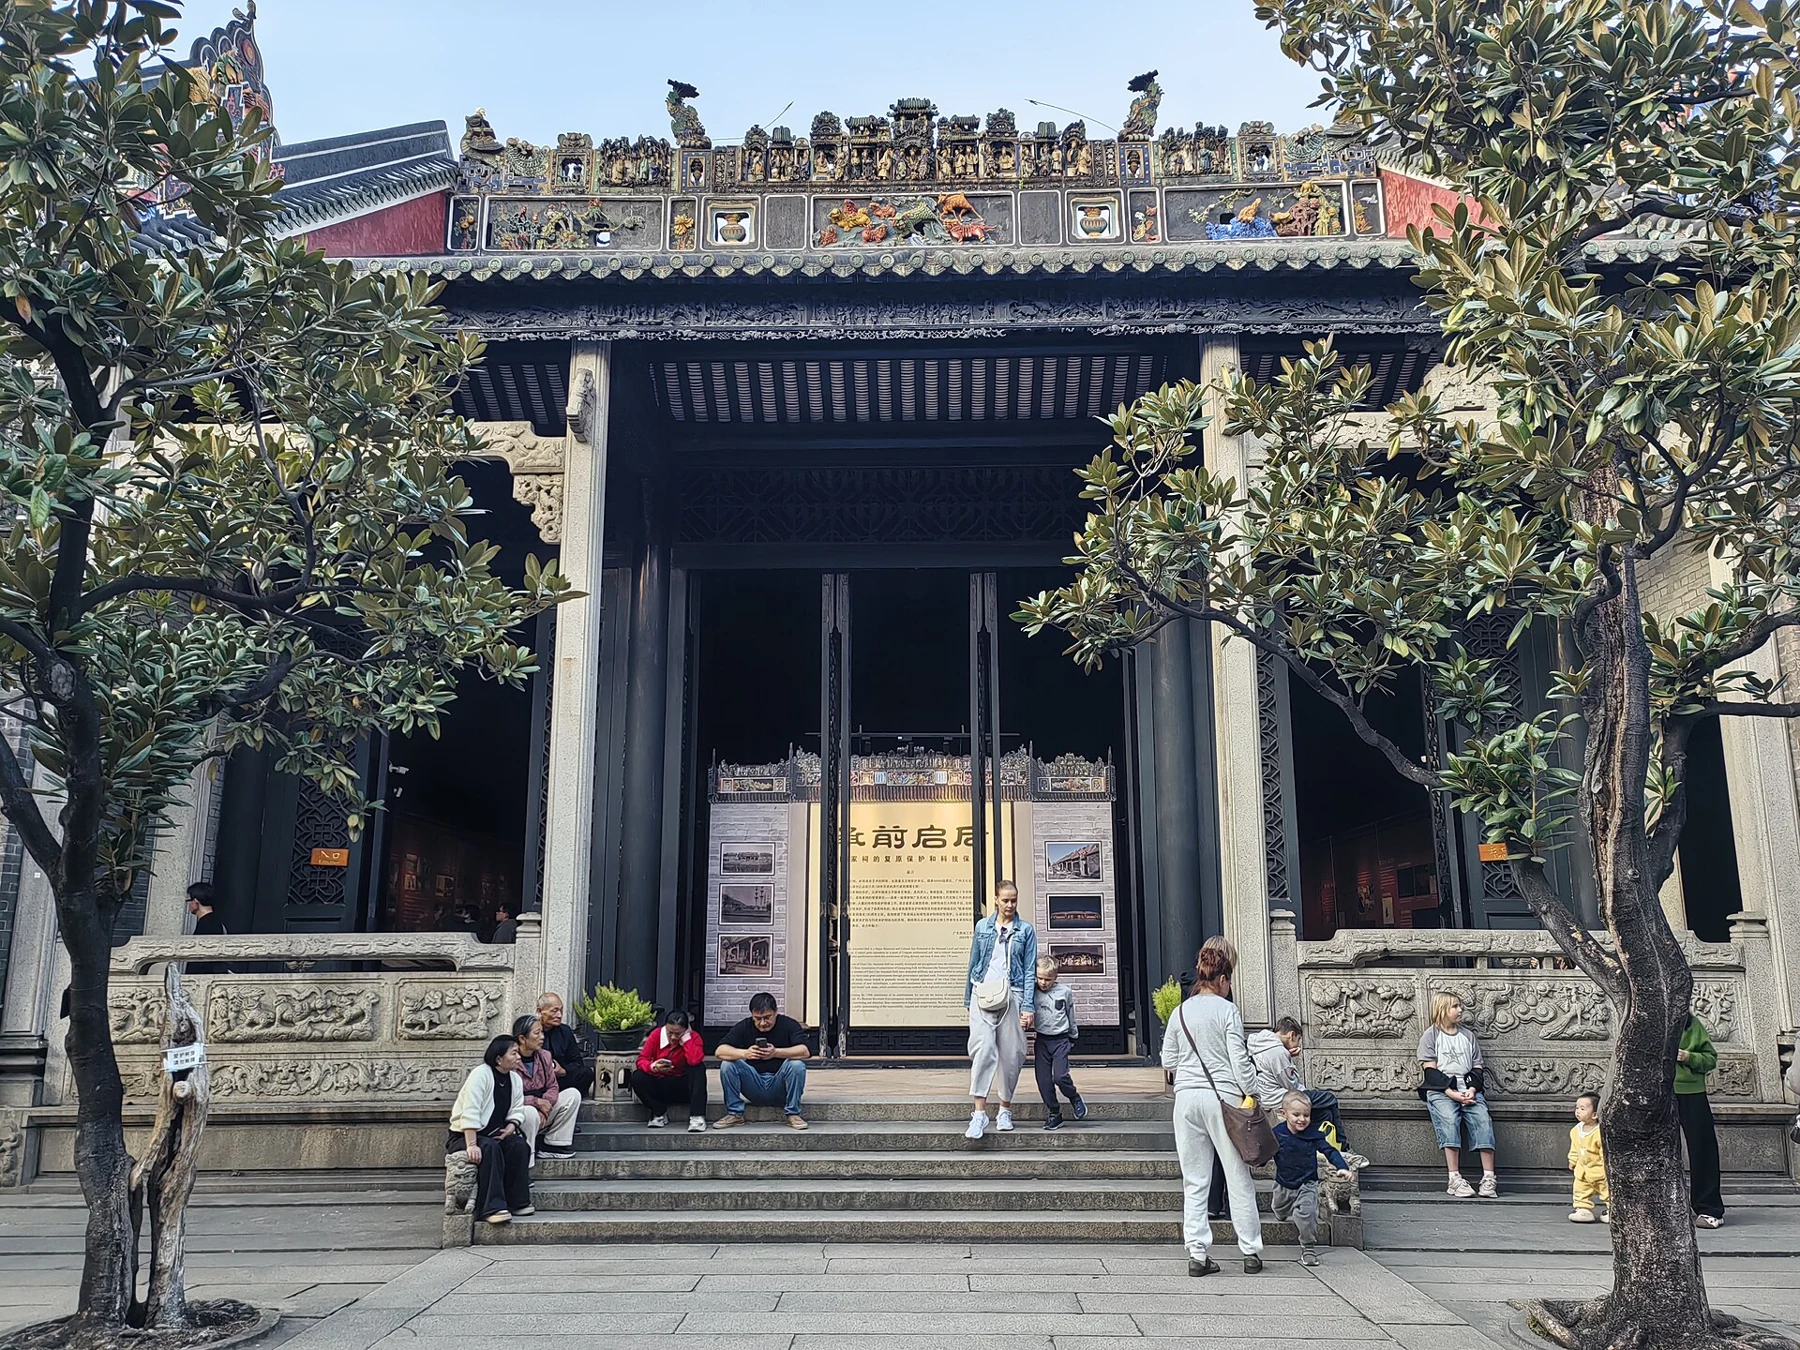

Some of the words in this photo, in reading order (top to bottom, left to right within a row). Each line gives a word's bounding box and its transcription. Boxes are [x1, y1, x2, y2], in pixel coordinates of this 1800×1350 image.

[319, 850, 341, 859] 入口
[840, 855, 970, 863] 家祠的复原保护和科技保
